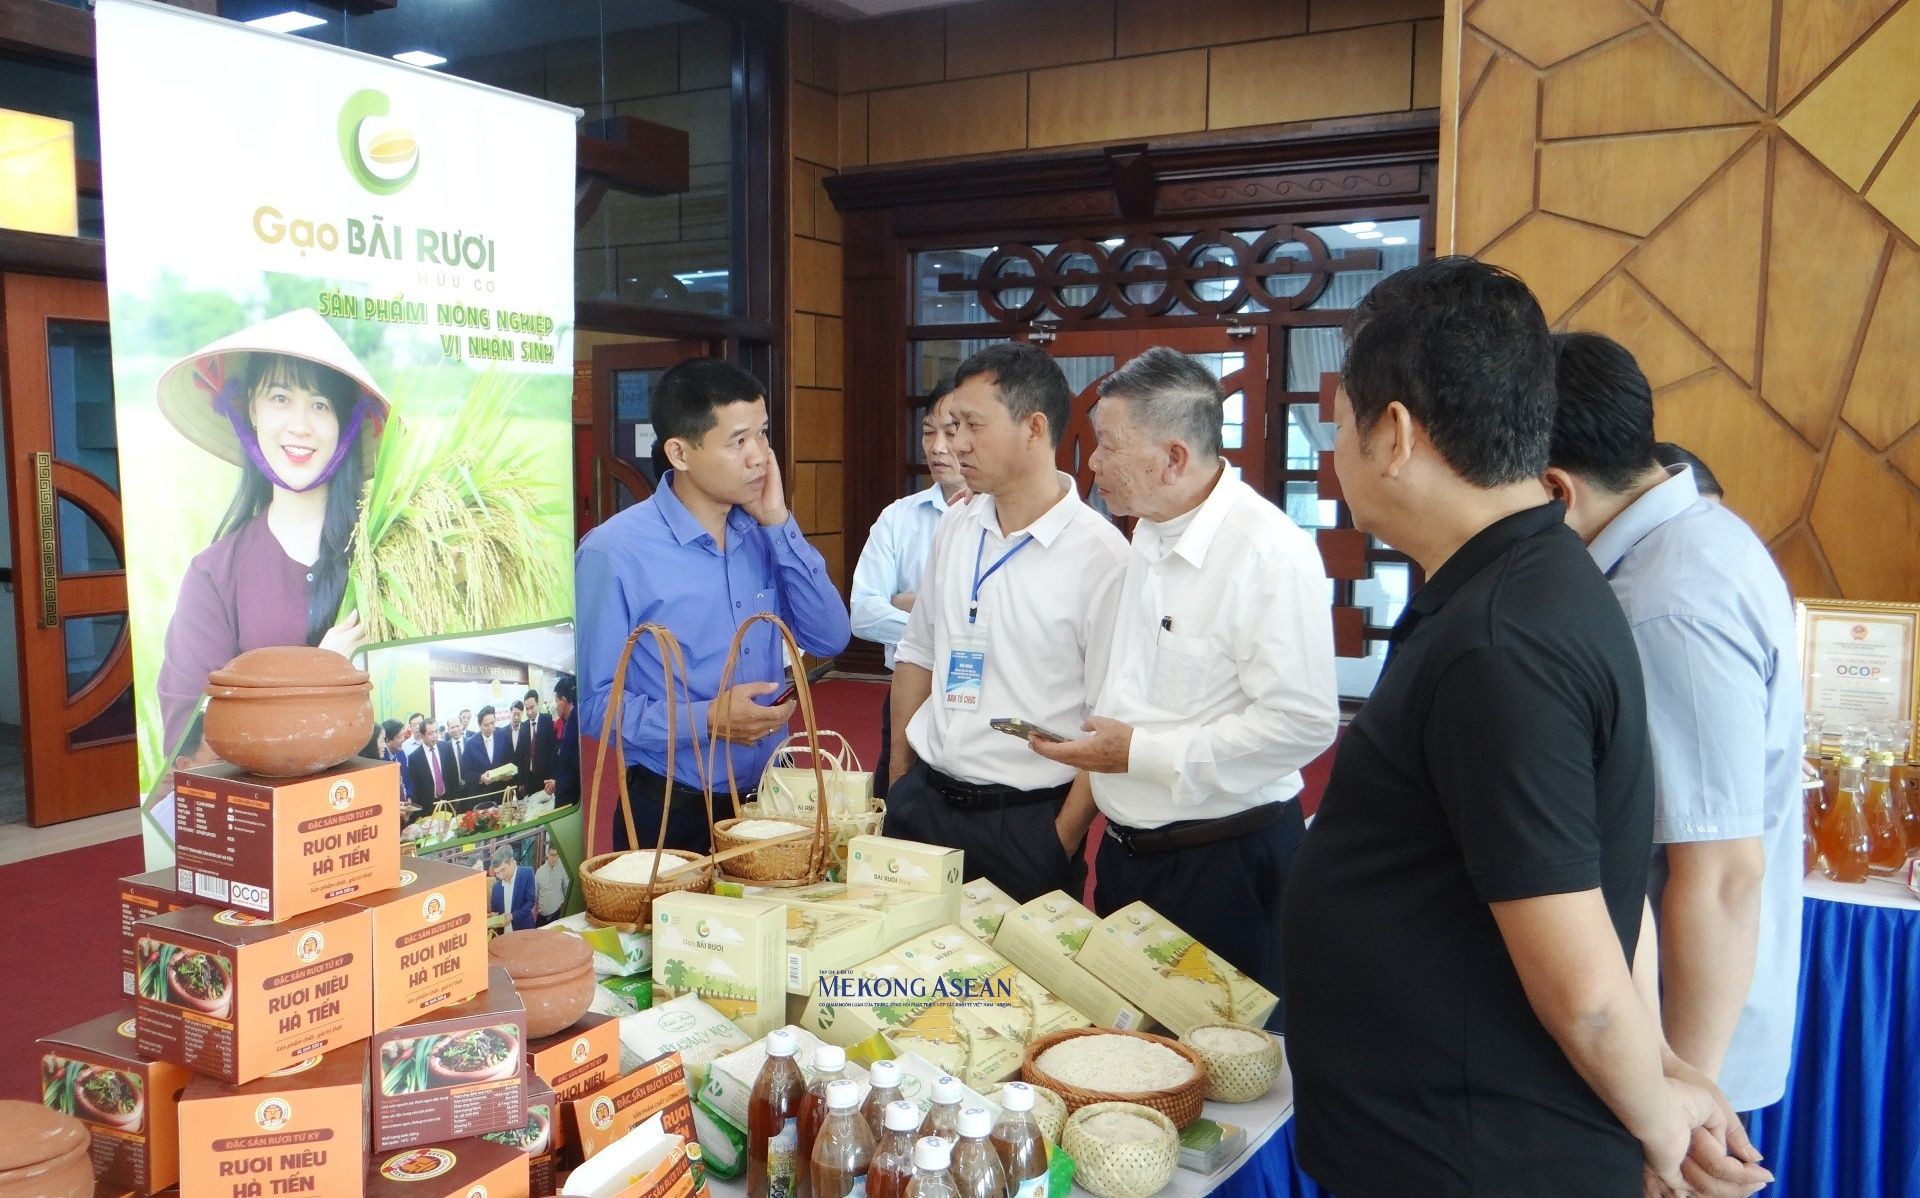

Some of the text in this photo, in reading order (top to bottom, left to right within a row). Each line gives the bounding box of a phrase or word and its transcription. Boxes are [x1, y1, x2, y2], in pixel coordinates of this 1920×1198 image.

[252, 205, 495, 272] Gạo BÃI RƯƠI
[318, 288, 553, 340] SẢN PHẨM NÔNG NGHIỆP
[440, 335, 554, 364] VỊ NHÂN SINH
[1836, 664, 1880, 677] OCOP
[303, 825, 378, 856] RƯƠI NIÊU
[339, 846, 370, 869] TIẾN
[232, 884, 268, 904] OCOP
[400, 933, 467, 970] RƯƠI NIÊU
[433, 954, 460, 978] TIẾN
[269, 974, 349, 1014] RƯƠI NIÊU
[307, 998, 340, 1024] TIẾN
[219, 1149, 327, 1177] RƯƠI NIÊU
[270, 1171, 315, 1195] TIẾN
